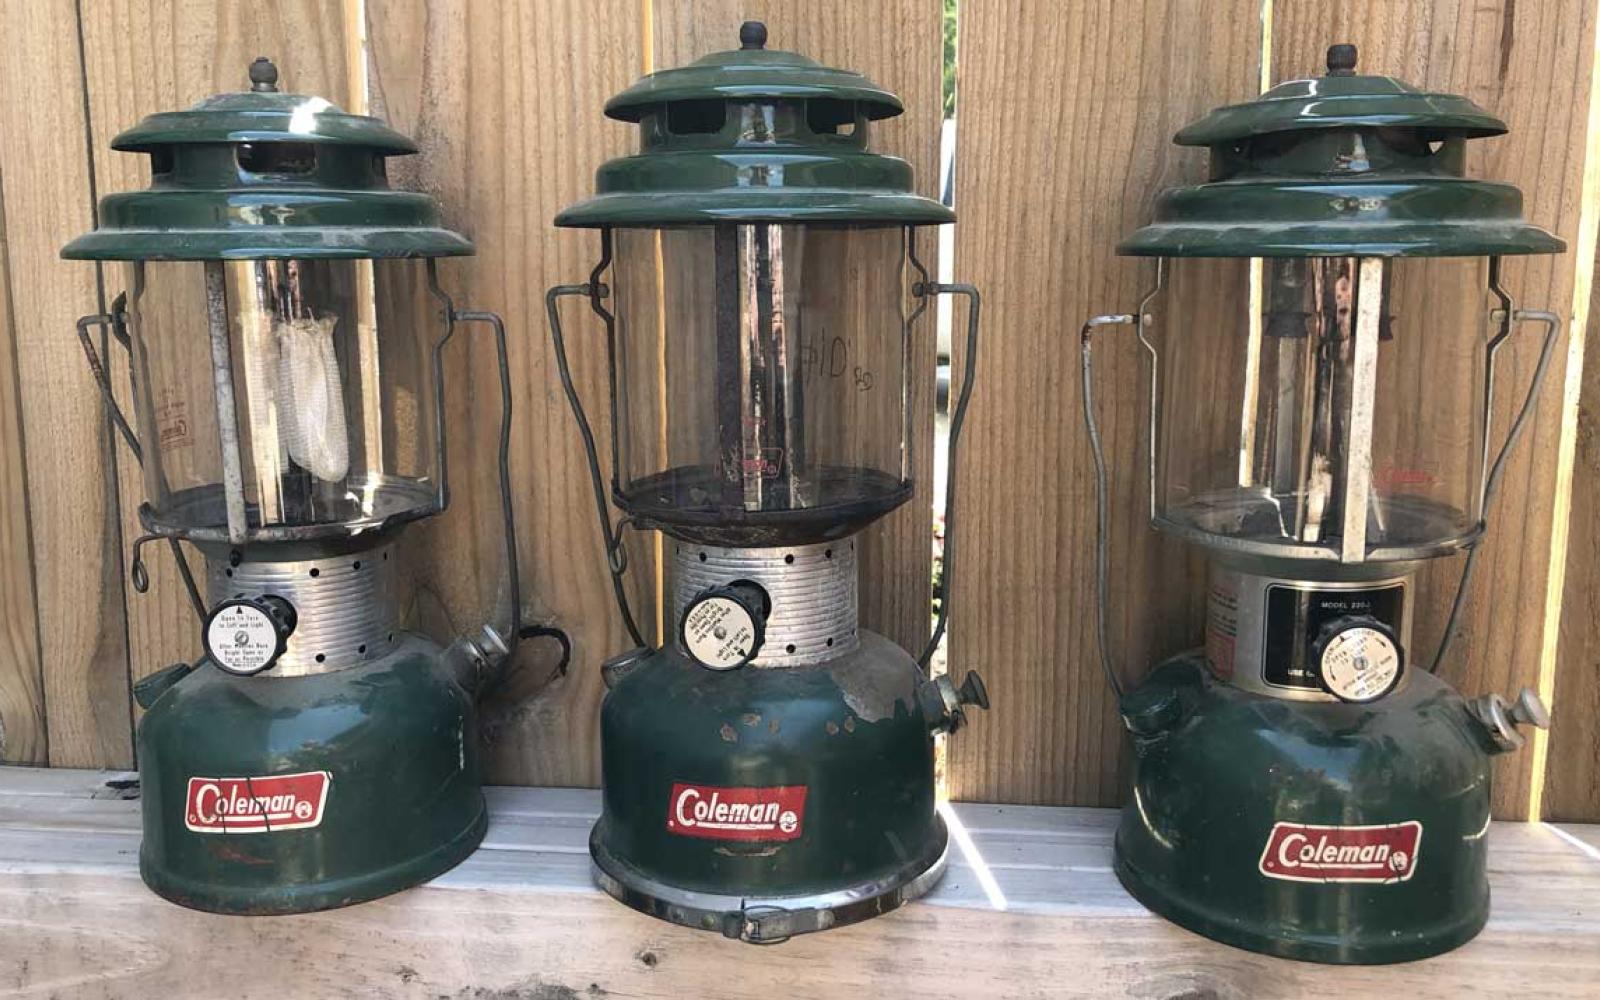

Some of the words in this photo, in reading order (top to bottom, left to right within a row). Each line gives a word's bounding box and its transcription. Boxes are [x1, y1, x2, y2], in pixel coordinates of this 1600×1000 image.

[196, 783, 295, 824] Coleman
[676, 788, 780, 830] Coleman
[1279, 833, 1391, 868] Coleman
